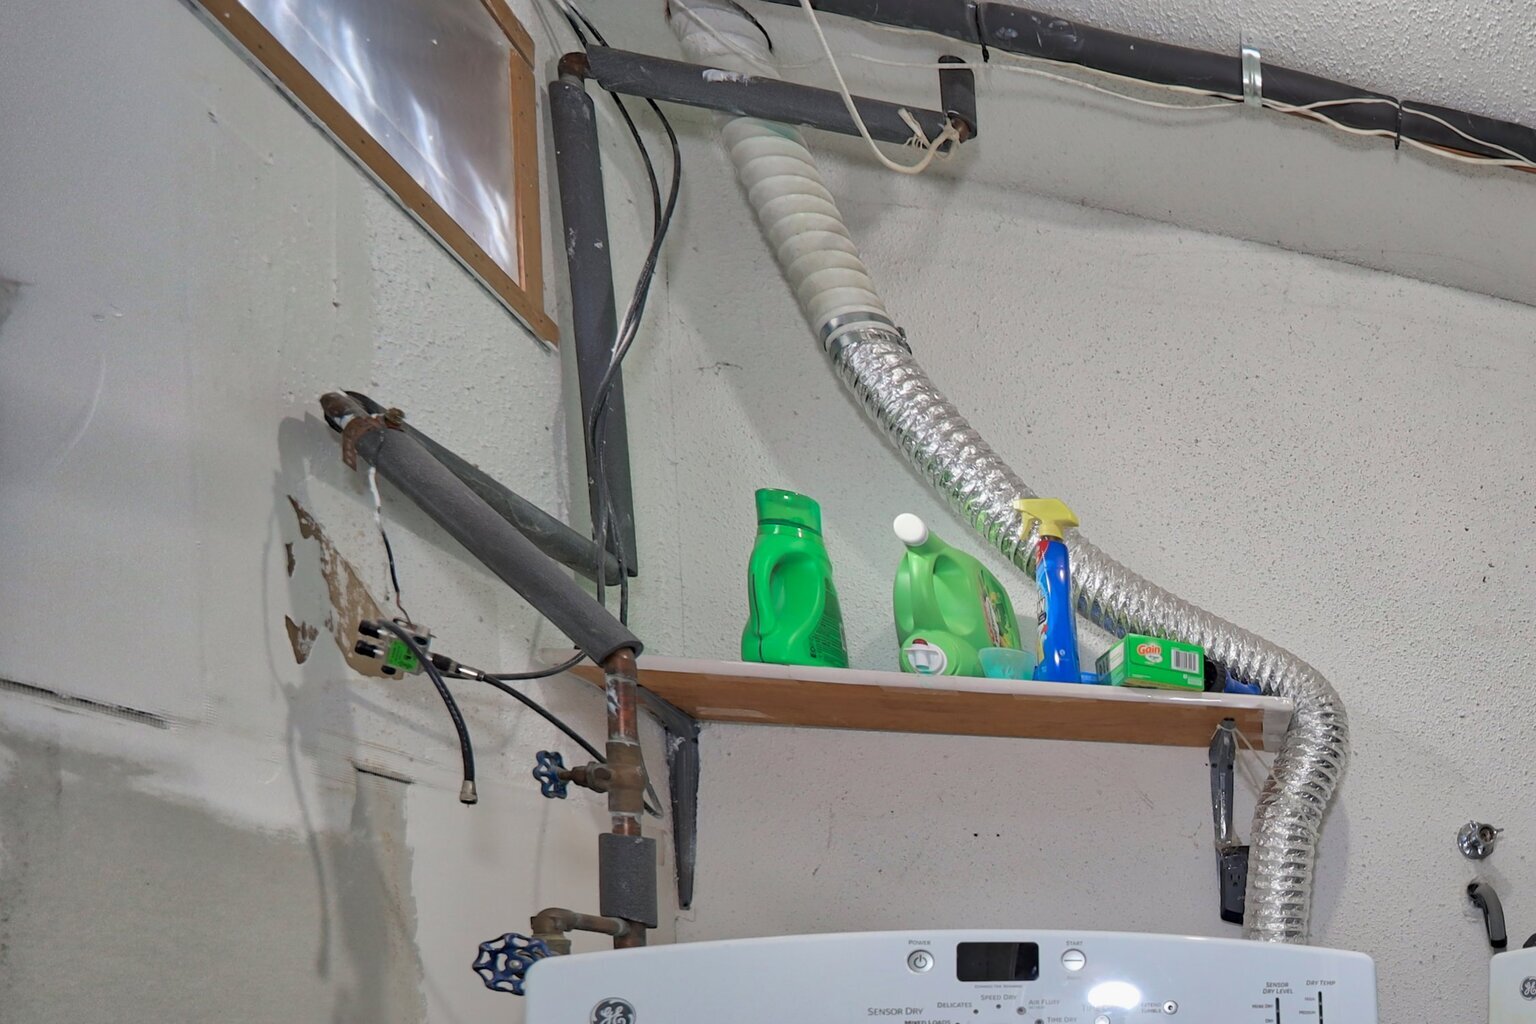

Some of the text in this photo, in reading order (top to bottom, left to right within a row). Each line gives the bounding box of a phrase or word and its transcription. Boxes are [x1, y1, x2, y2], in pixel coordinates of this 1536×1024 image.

[1138, 643, 1161, 655] Gain
[868, 1007, 923, 1016] SENSOR DRY
